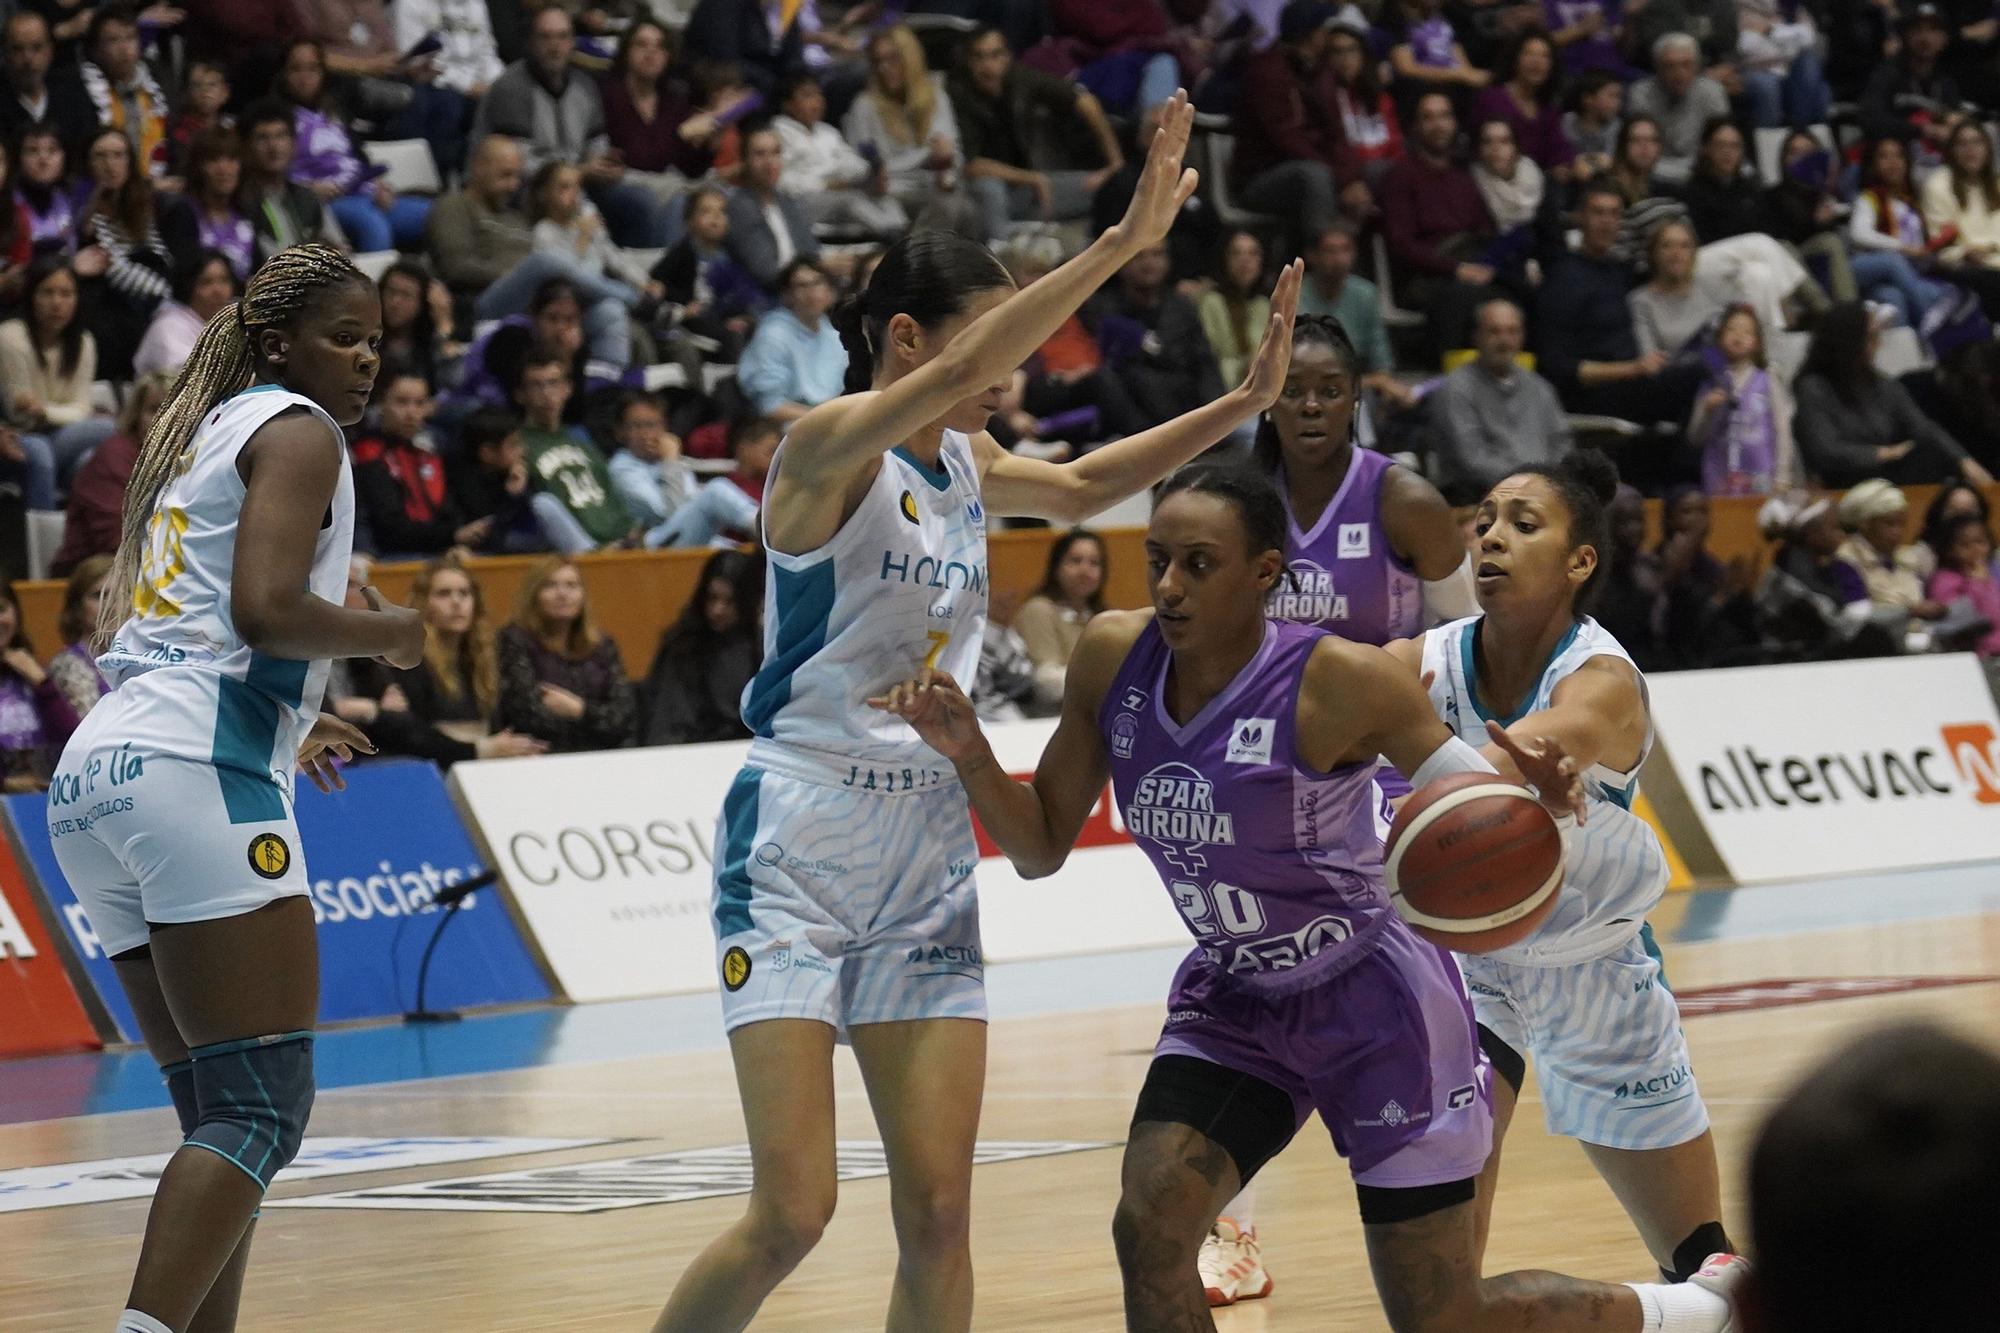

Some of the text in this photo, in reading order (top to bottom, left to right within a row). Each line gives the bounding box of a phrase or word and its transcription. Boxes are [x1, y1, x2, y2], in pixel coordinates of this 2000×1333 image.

[1137, 776, 1211, 811] SPAR
[1126, 804, 1236, 846] GIRONA
[1169, 877, 1268, 940] 20
[927, 944, 983, 965] ACTÚ
